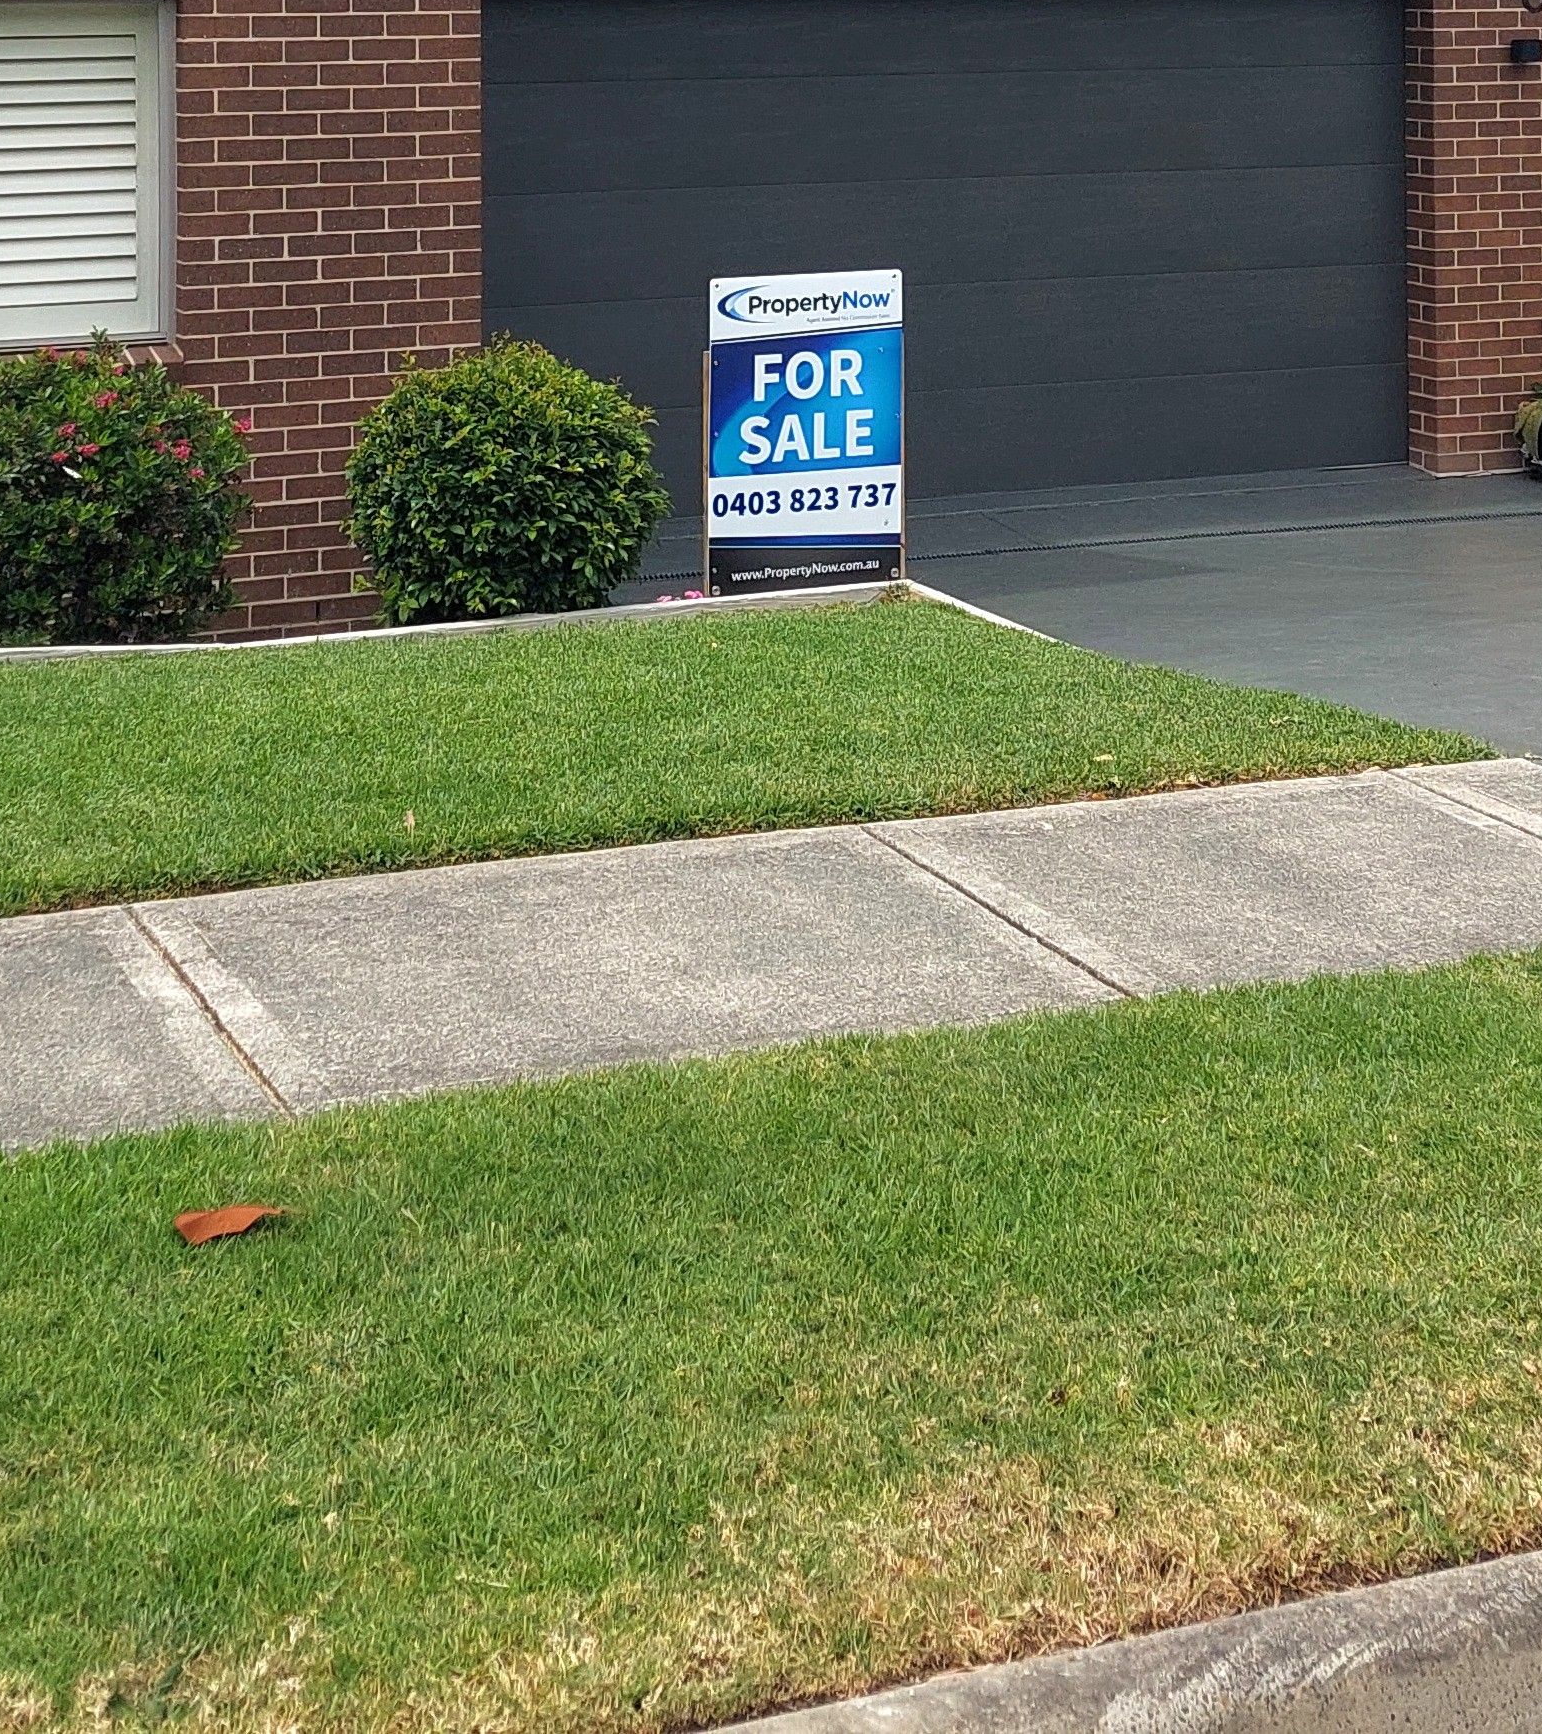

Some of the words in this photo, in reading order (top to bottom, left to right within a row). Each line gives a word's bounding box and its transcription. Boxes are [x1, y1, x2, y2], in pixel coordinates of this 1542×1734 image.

[748, 290, 890, 316] PropertyNow
[753, 349, 863, 402] FOR
[739, 409, 874, 465] SALE
[712, 490, 781, 517] 0403
[789, 487, 839, 513] 823
[847, 483, 897, 508] 737
[731, 559, 879, 582] www.PropertyNow.com.au
